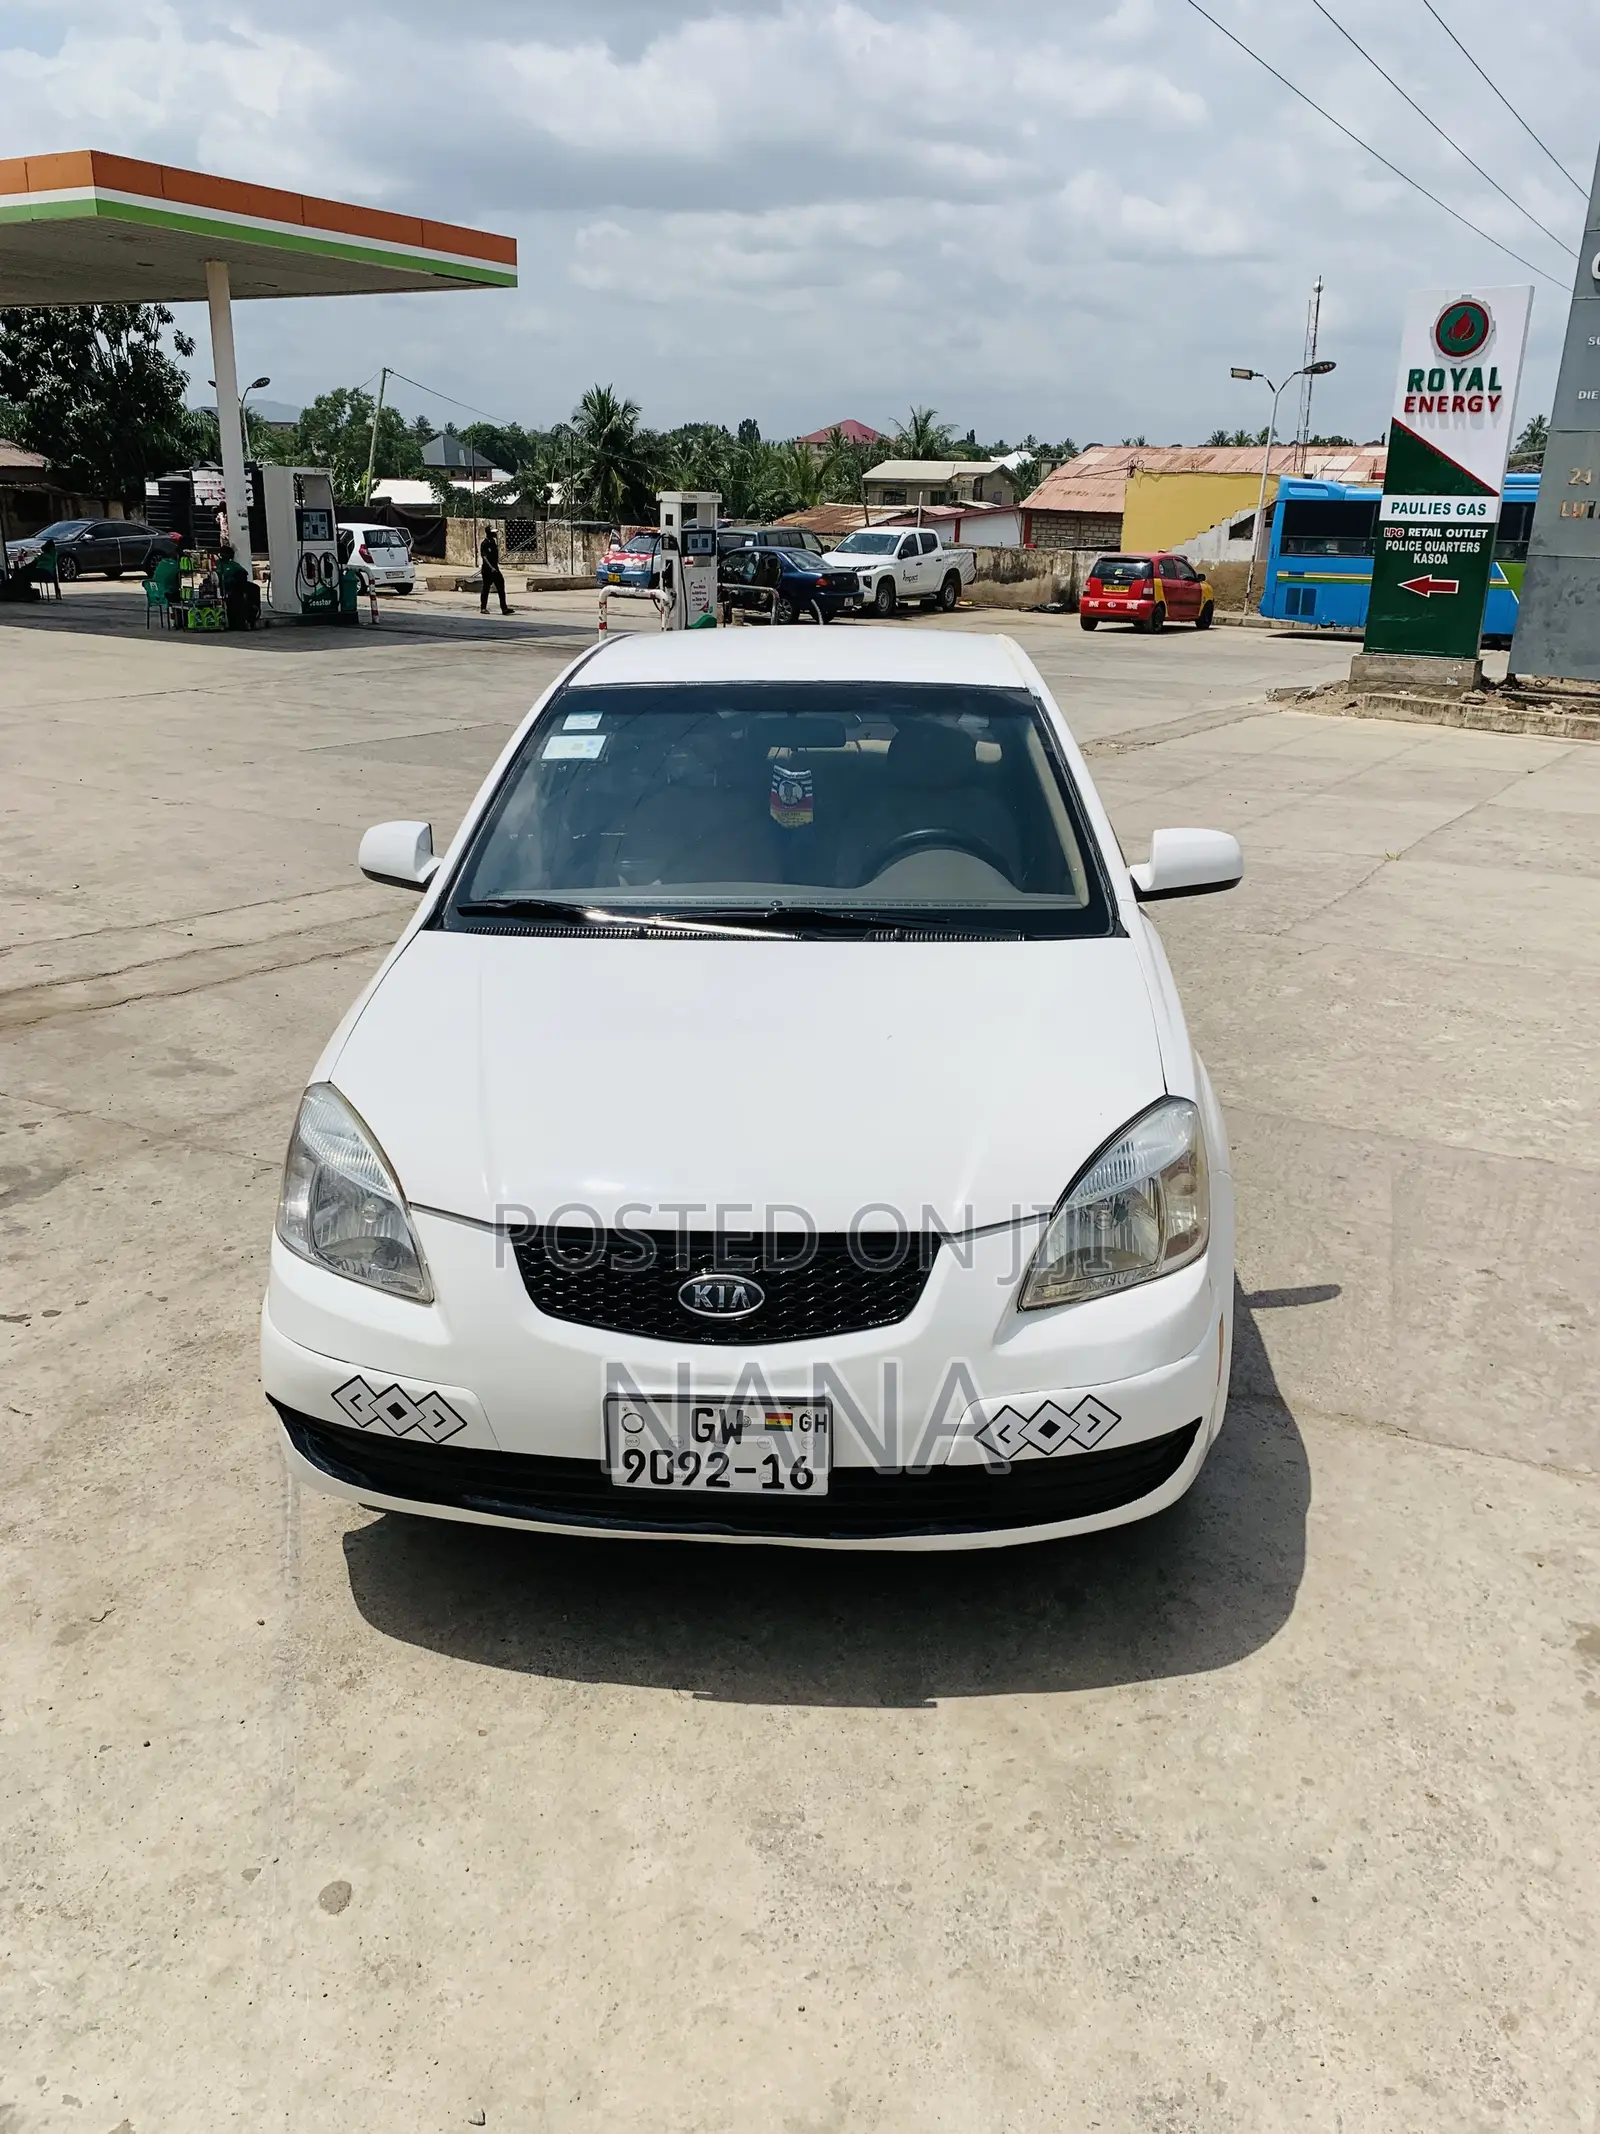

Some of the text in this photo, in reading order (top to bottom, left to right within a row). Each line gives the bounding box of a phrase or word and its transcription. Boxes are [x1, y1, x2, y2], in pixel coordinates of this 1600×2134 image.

[1407, 367, 1502, 392] ROYAL
[1578, 390, 1599, 400] DIE
[1404, 395, 1501, 413] ENERGY
[1391, 502, 1487, 516] PAULIES GAS
[1383, 527, 1488, 539] LPG RETAIL OUTLET
[1385, 540, 1480, 553] POLICE QUARTERS
[1413, 553, 1448, 565] KASOA
[692, 1284, 751, 1309] KIA
[692, 1407, 828, 1445] GW GH
[622, 1448, 814, 1490] 9092-16
